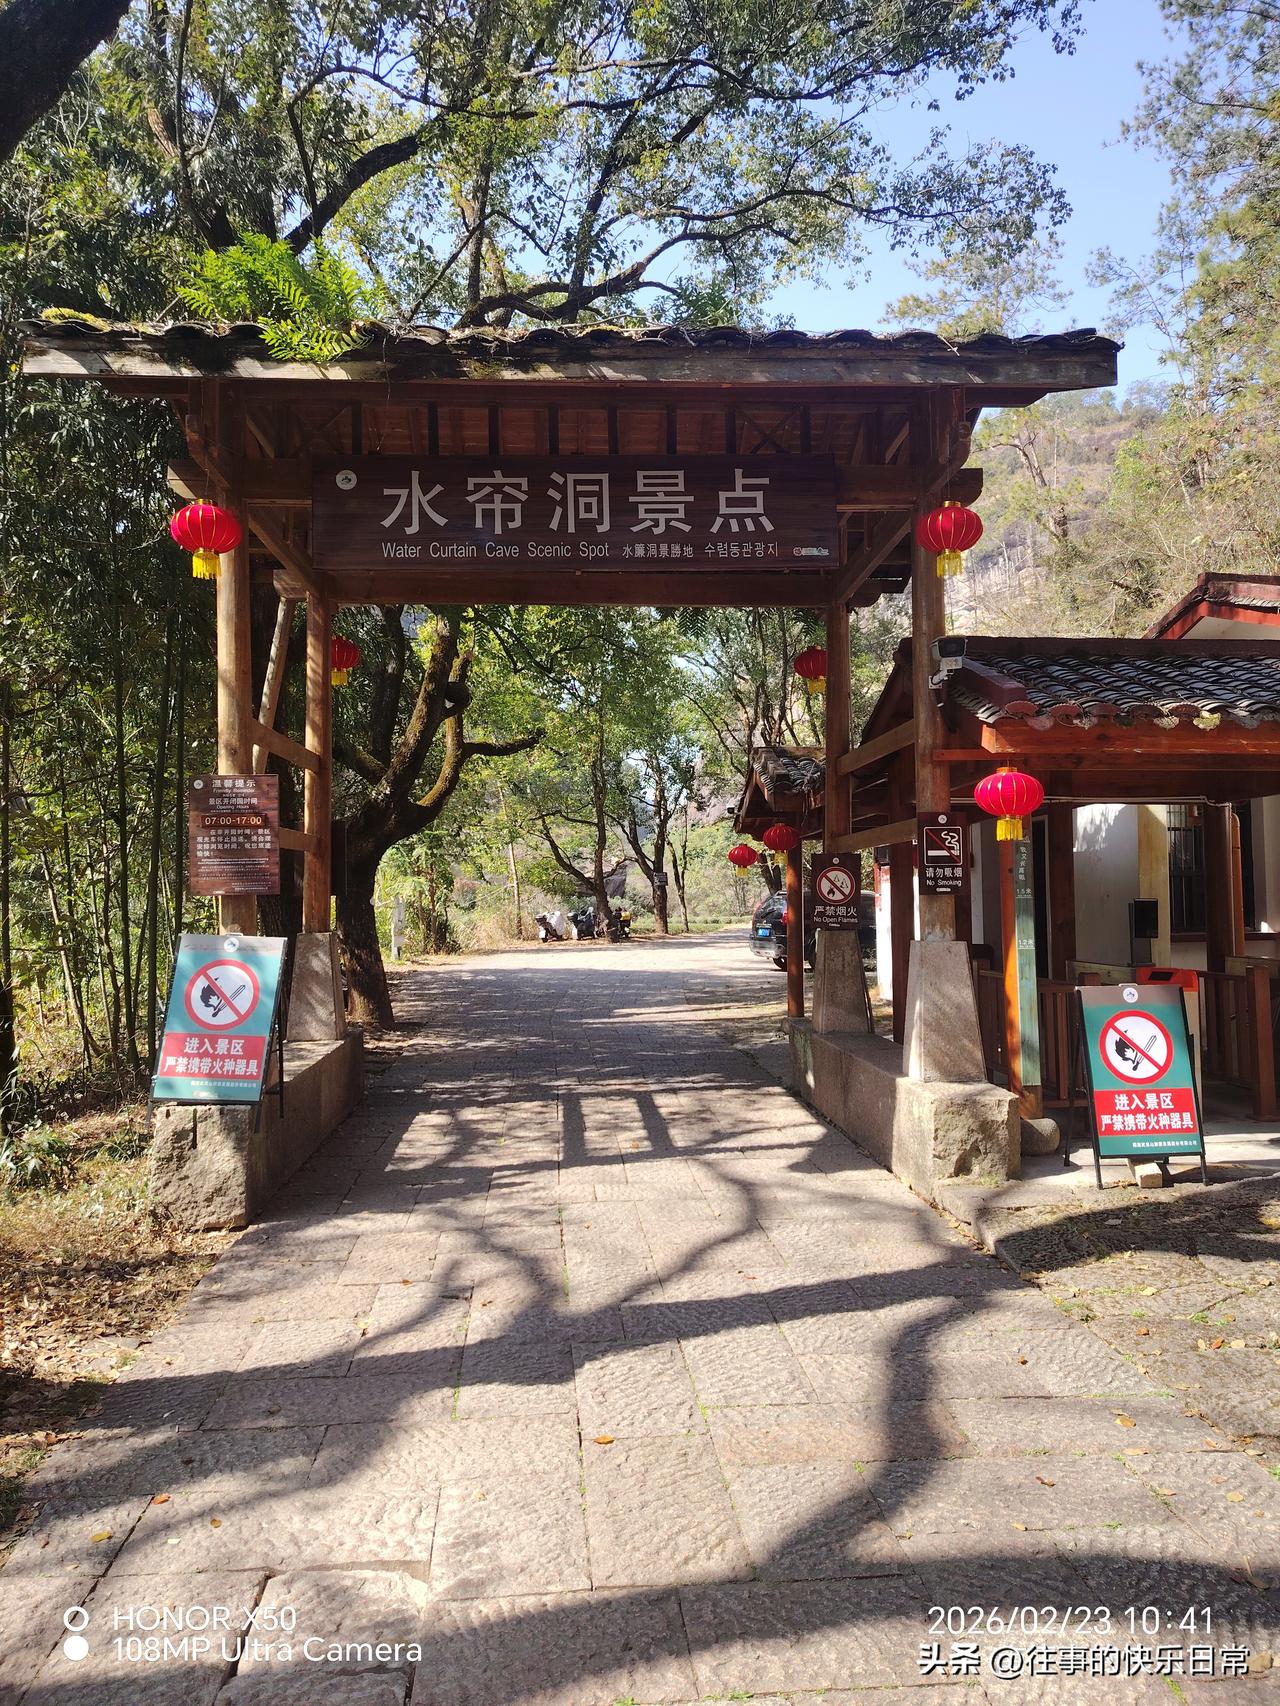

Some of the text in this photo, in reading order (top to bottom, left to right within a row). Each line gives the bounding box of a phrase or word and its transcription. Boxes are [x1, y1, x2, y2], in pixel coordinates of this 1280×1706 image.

[379, 468, 776, 535] 水帘洞景点
[381, 541, 610, 562] Water Curtain Cave Scenic Spot
[621, 543, 695, 559] 水簾洞景勝地
[704, 541, 779, 559] 수렴동관광지
[212, 779, 256, 788] 温馨提示
[209, 797, 258, 805] 景区开闭园时间
[205, 816, 262, 825] 07:00-17:00
[925, 867, 963, 878] 请勿吸烟
[937, 879, 962, 887] Smoking
[814, 905, 858, 916] 严禁烟火
[822, 916, 838, 924] Open
[183, 1037, 244, 1055] 进入景区
[163, 1056, 258, 1075] 严禁携带火种器具
[1114, 1092, 1175, 1111] 进入景区
[1100, 1112, 1194, 1131] 严禁携带火种器具
